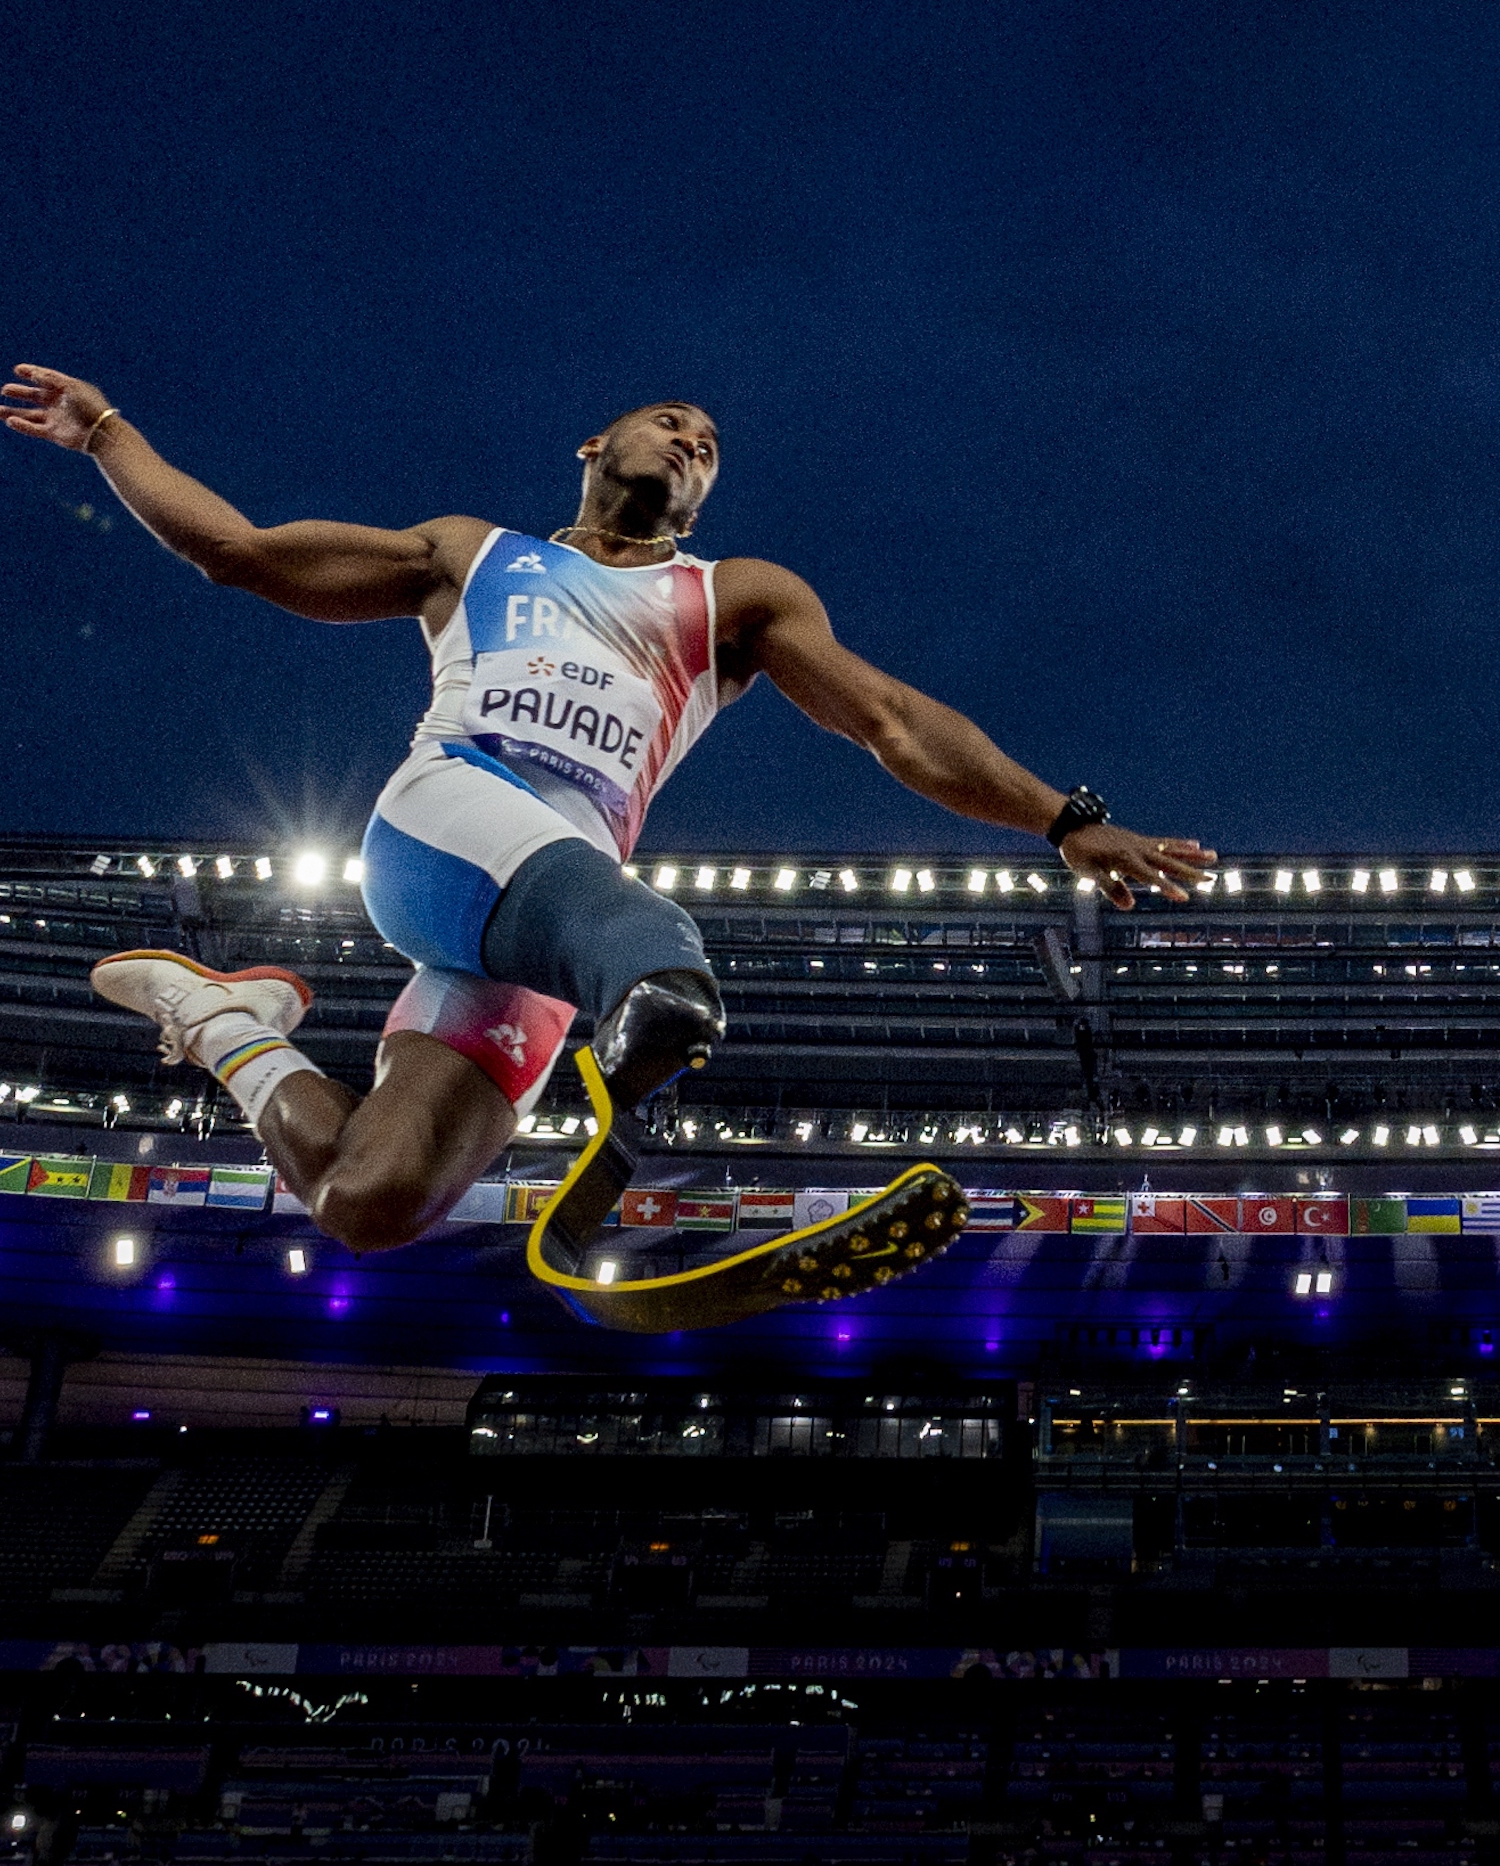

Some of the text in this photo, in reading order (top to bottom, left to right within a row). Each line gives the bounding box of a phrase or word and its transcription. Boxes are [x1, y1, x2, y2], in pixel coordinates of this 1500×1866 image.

[480, 688, 644, 770] PAVADE
[529, 751, 573, 774] PARIS
[340, 1652, 457, 1668] PARIS 2024
[790, 1655, 908, 1671] PARIS 2024
[1165, 1655, 1281, 1671] PARIS 2024
